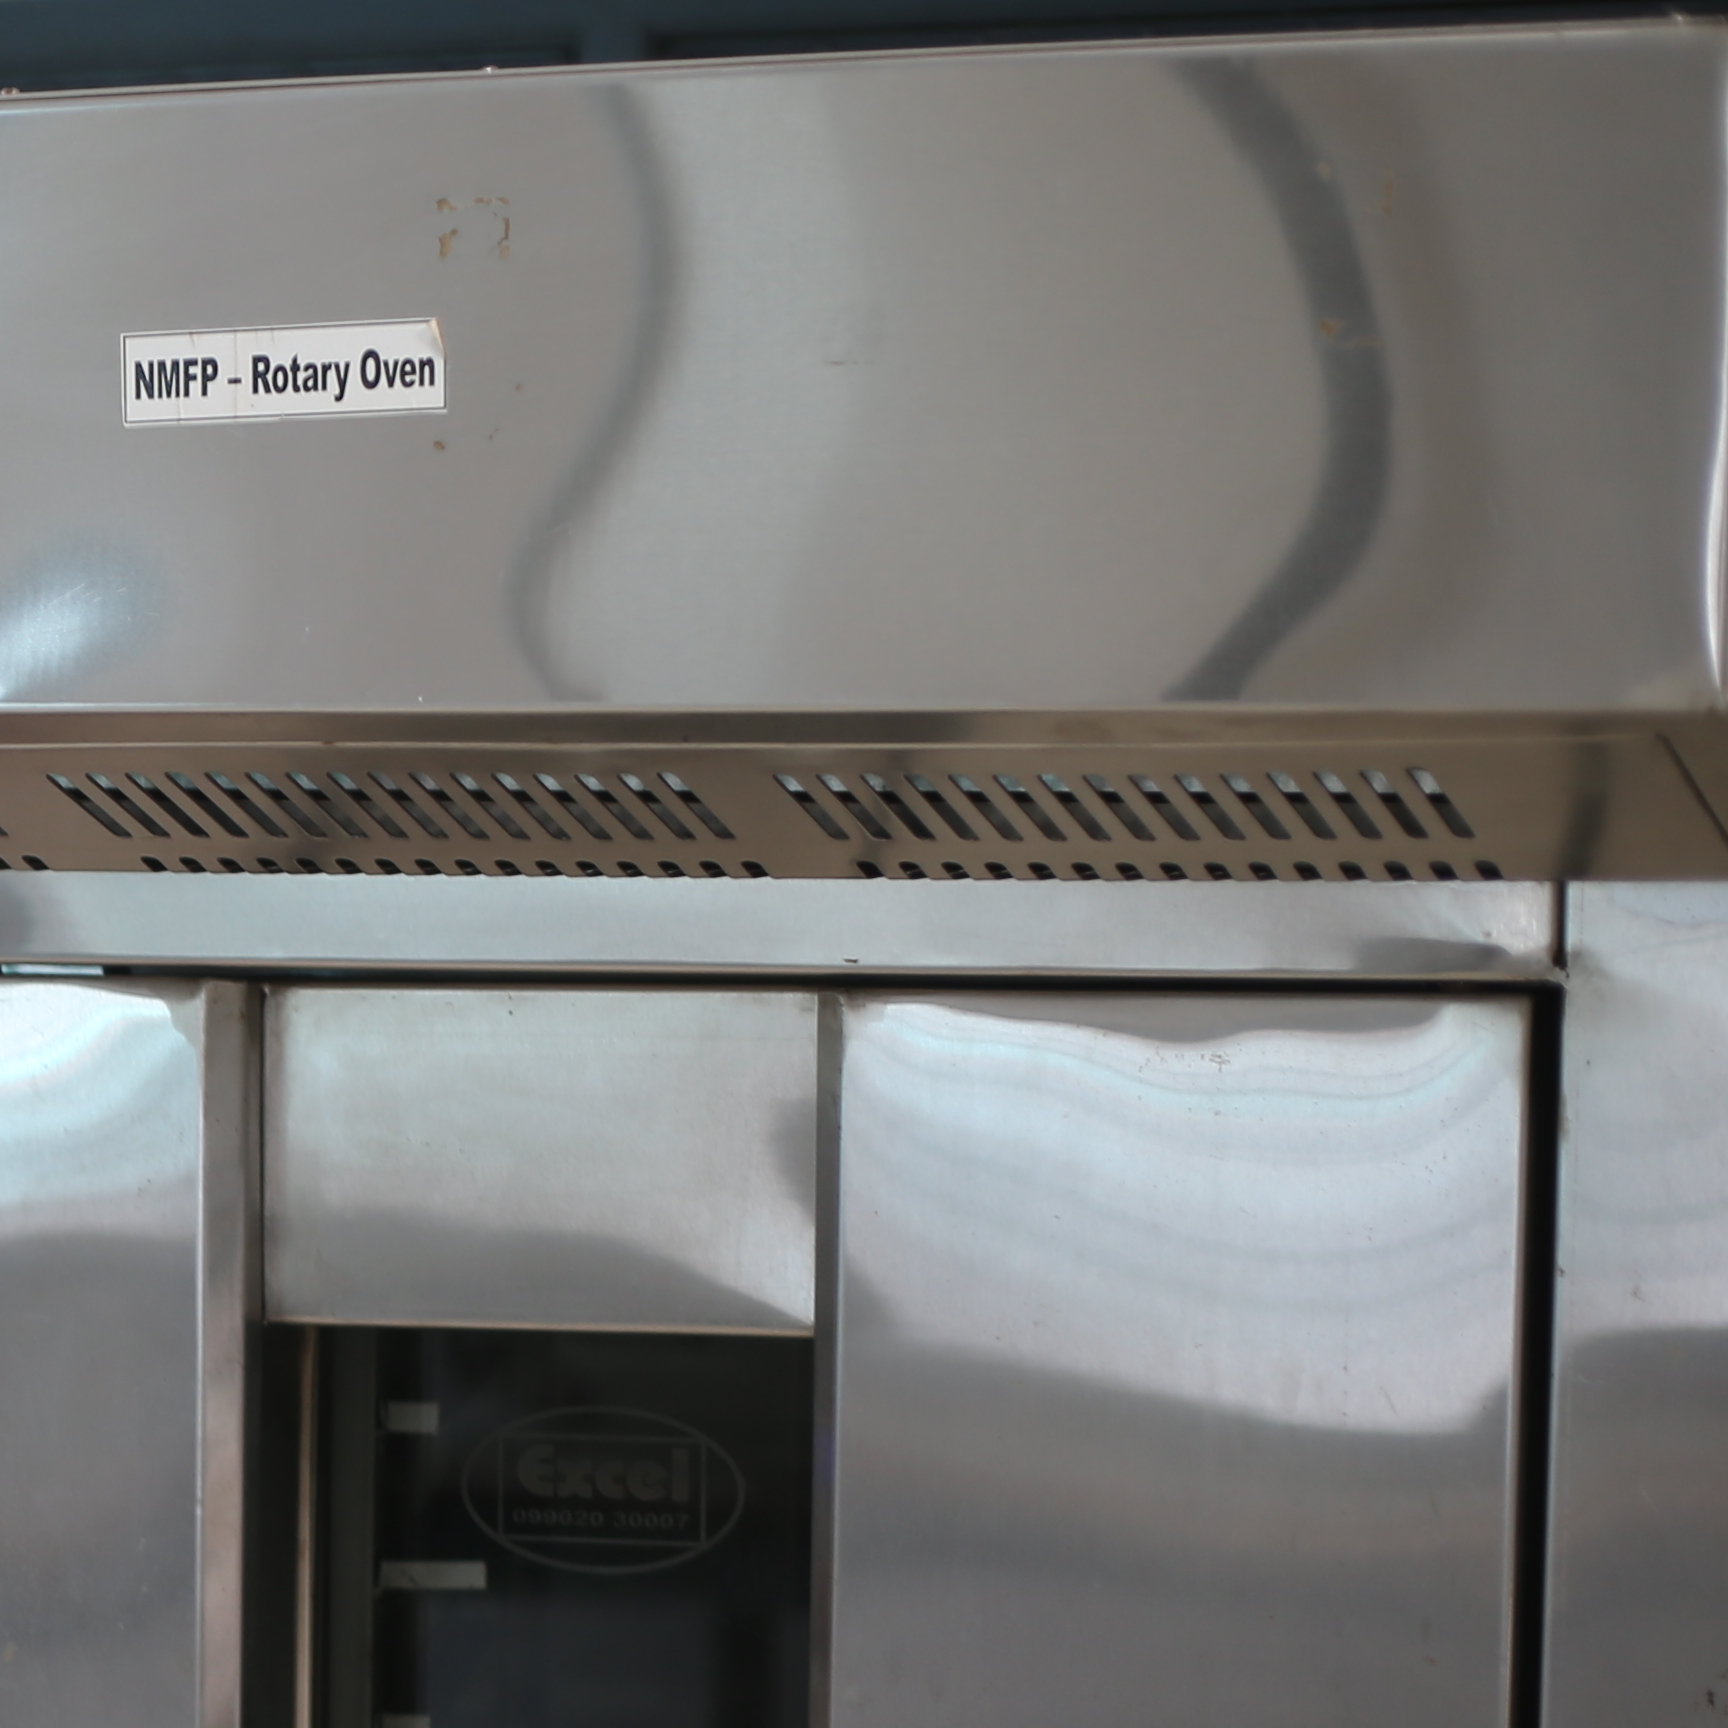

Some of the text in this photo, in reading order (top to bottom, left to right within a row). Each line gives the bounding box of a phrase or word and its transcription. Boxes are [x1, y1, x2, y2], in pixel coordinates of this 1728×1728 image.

[134, 356, 219, 400] NMFP
[250, 351, 350, 402] Rotary
[359, 348, 436, 390] Oven
[516, 1443, 690, 1504] Excel
[512, 1507, 691, 1530] 099020 30007
